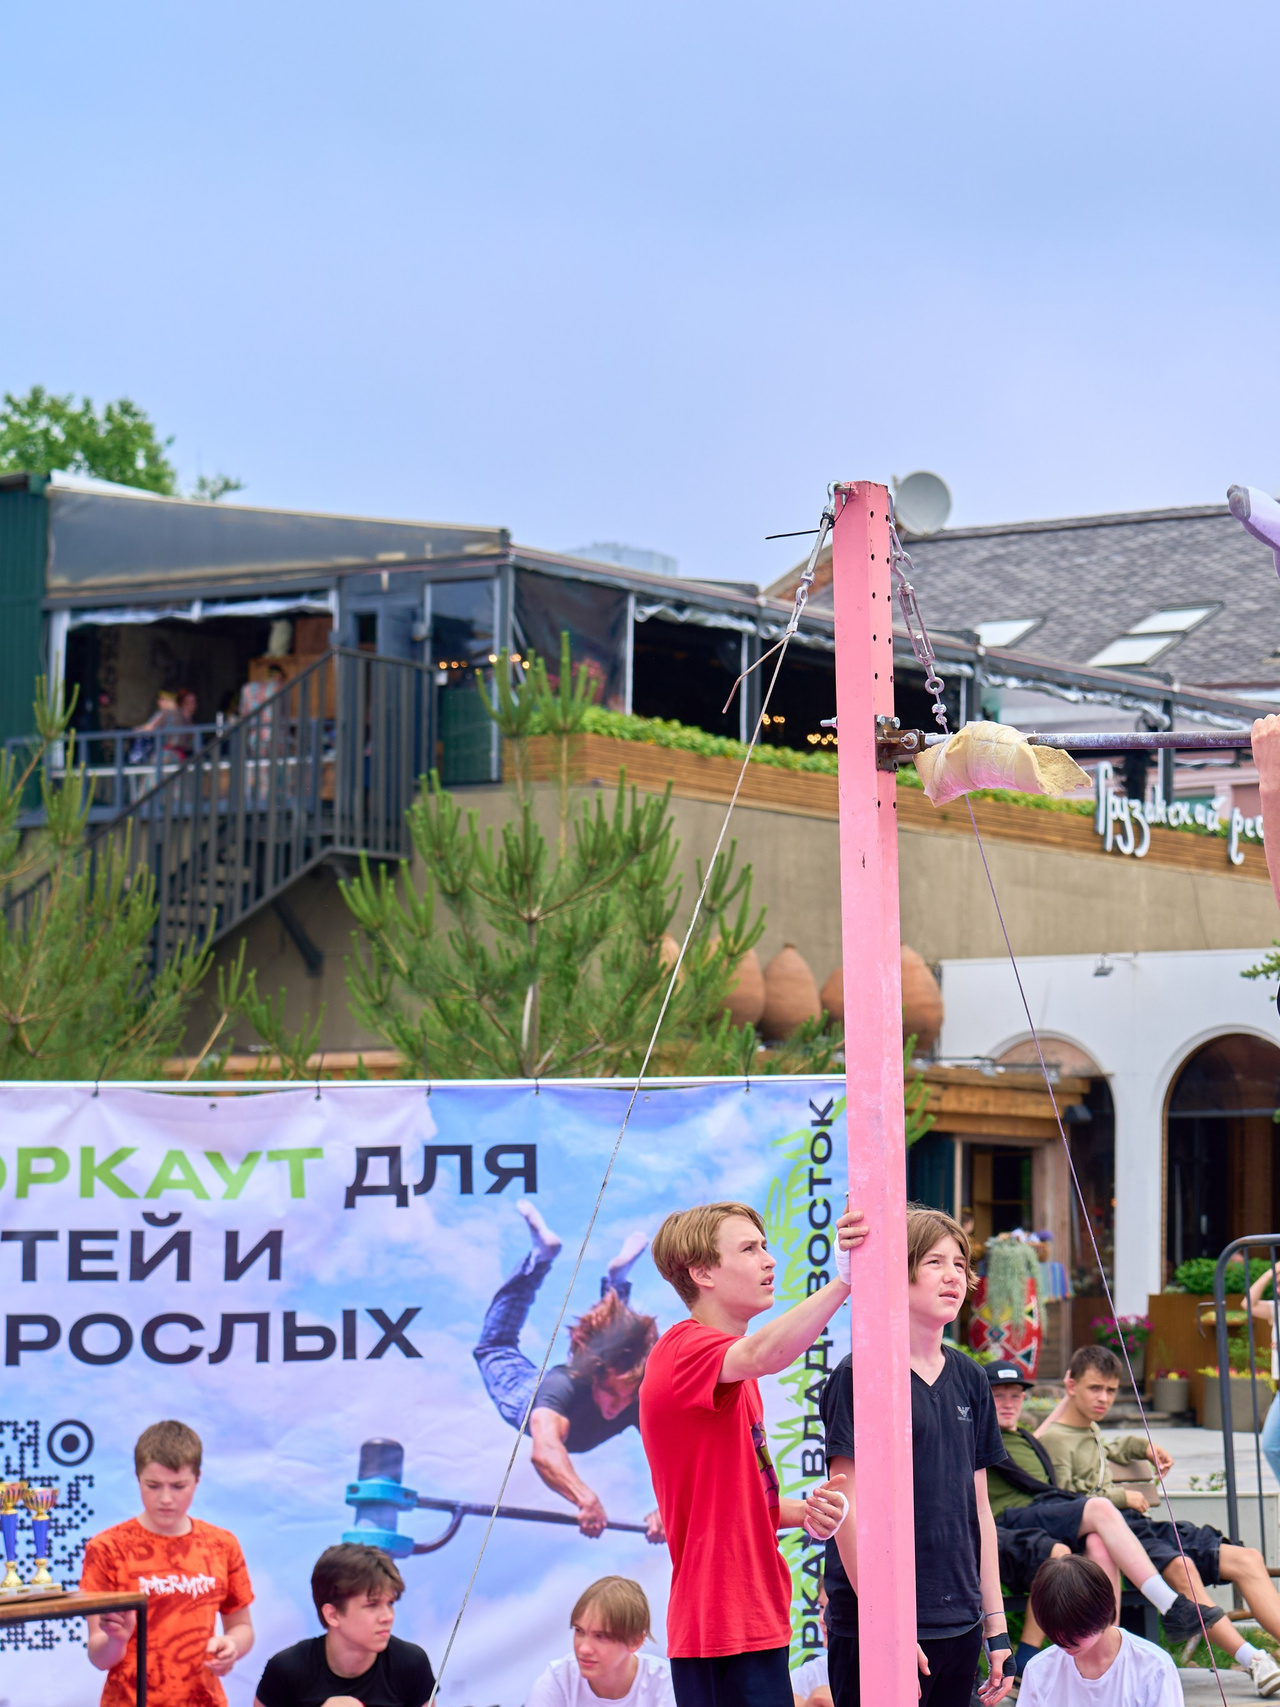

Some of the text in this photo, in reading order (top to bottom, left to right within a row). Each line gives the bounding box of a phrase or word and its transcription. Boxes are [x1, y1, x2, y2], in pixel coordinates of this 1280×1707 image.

[1094, 761, 1227, 858] Грузинский
[0, 1143, 538, 1209] РКАУТ ДЛЯ
[0, 1212, 284, 1282] ТЕЙ И
[801, 1097, 834, 1477] ВЛАДВОСТОК
[5, 1306, 423, 1366] РОСЛЫХ
